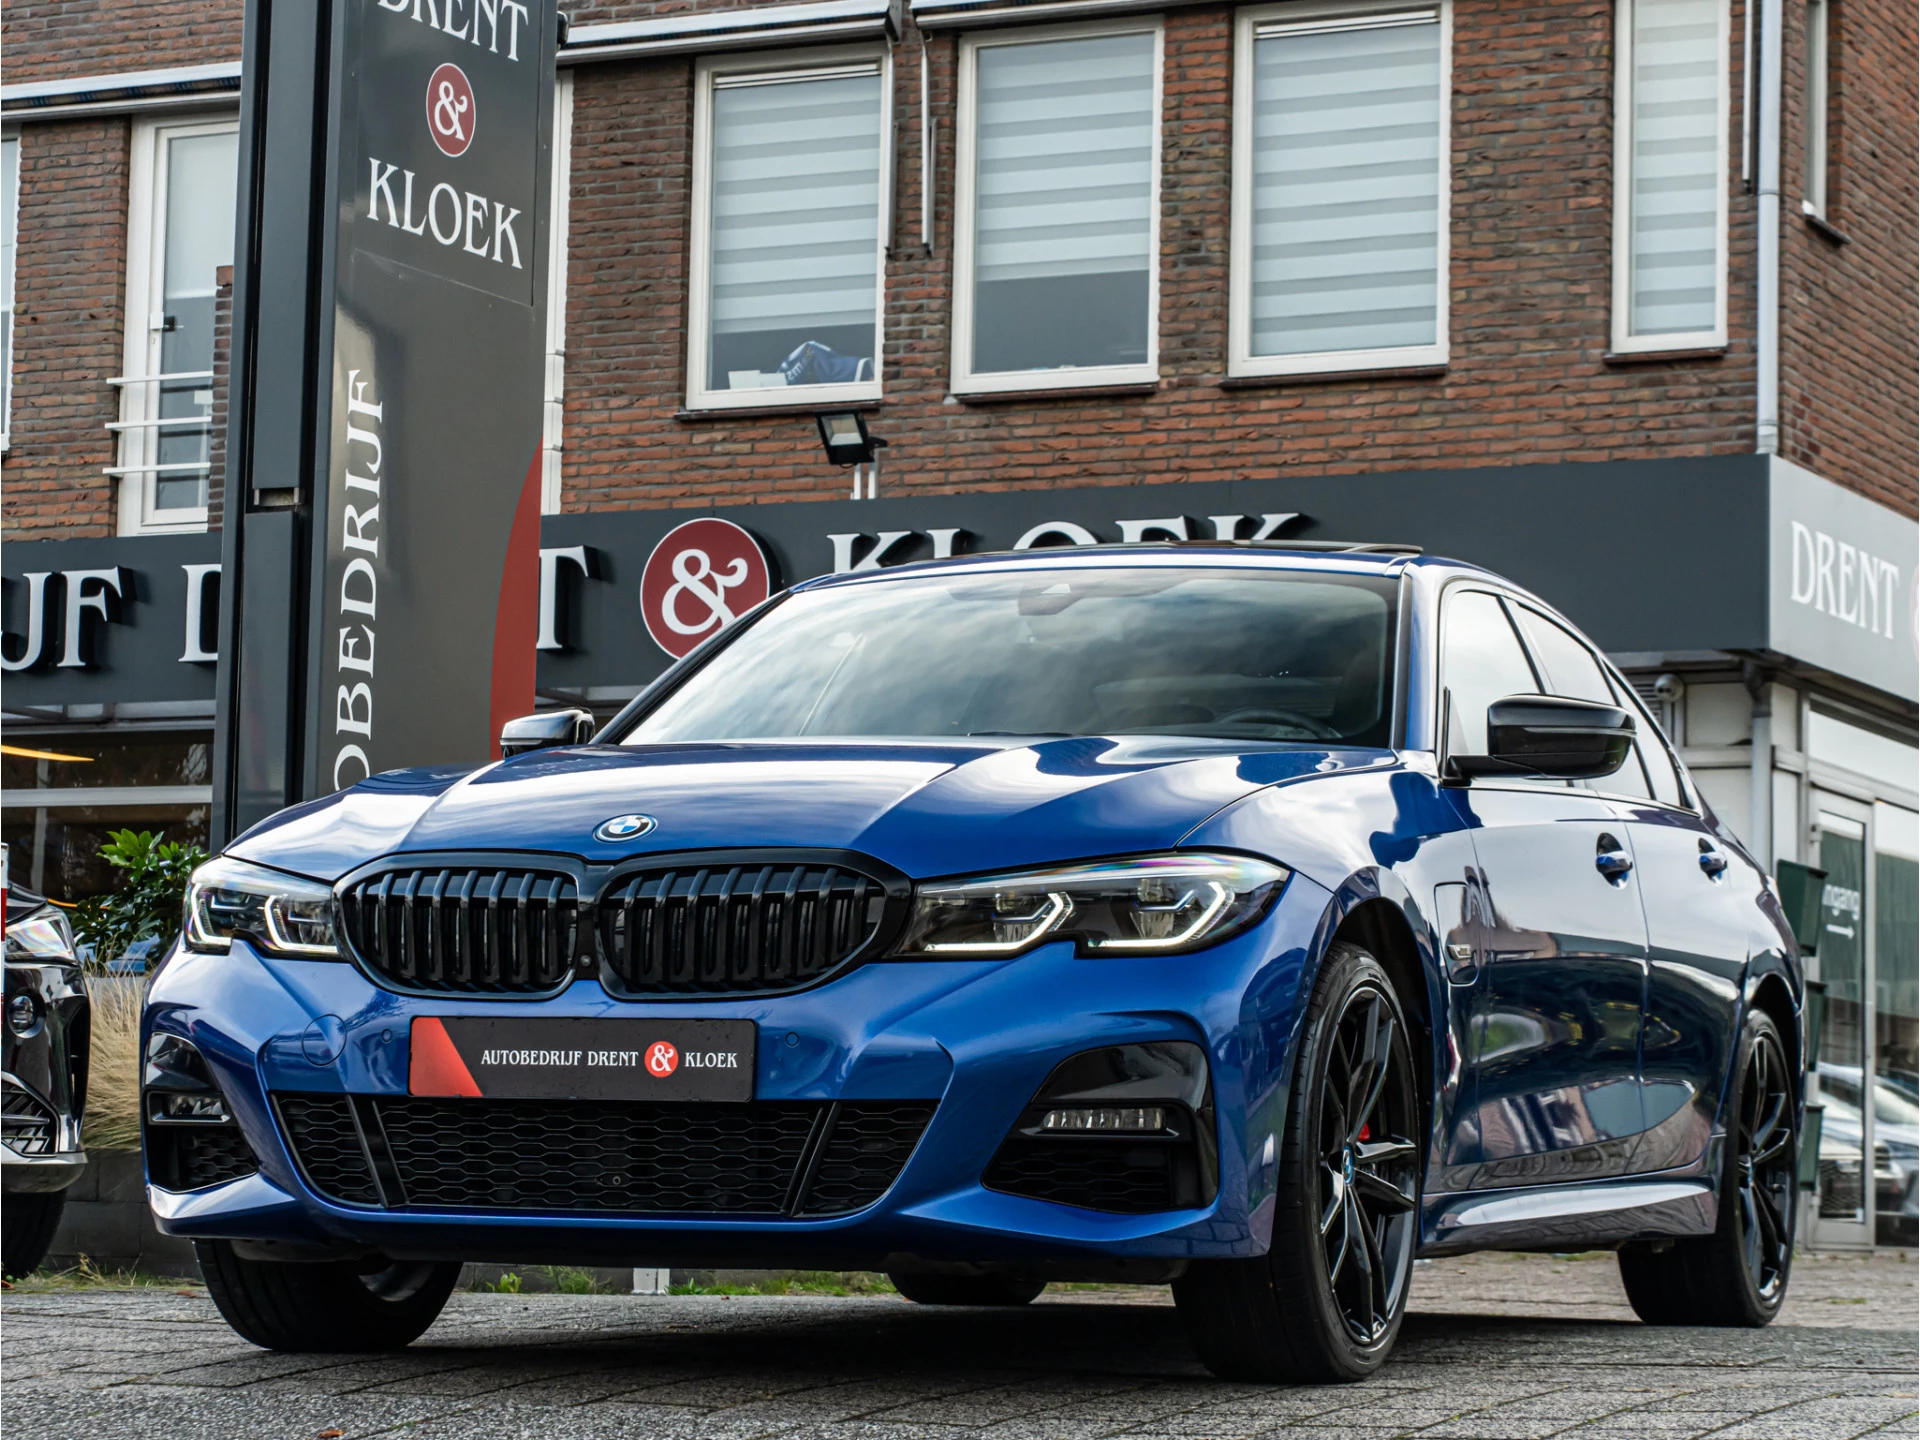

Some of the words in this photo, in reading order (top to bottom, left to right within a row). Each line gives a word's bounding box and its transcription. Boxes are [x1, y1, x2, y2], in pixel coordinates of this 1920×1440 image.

[434, 81, 468, 141] &
[367, 157, 523, 270] KLOEK
[661, 548, 748, 635] &
[1790, 519, 1900, 640] DRENT
[481, 1050, 583, 1066] AUTOBEDRIJF
[588, 1051, 639, 1067] DRENT
[650, 1045, 675, 1072] &
[685, 1053, 738, 1068] KLOEK
